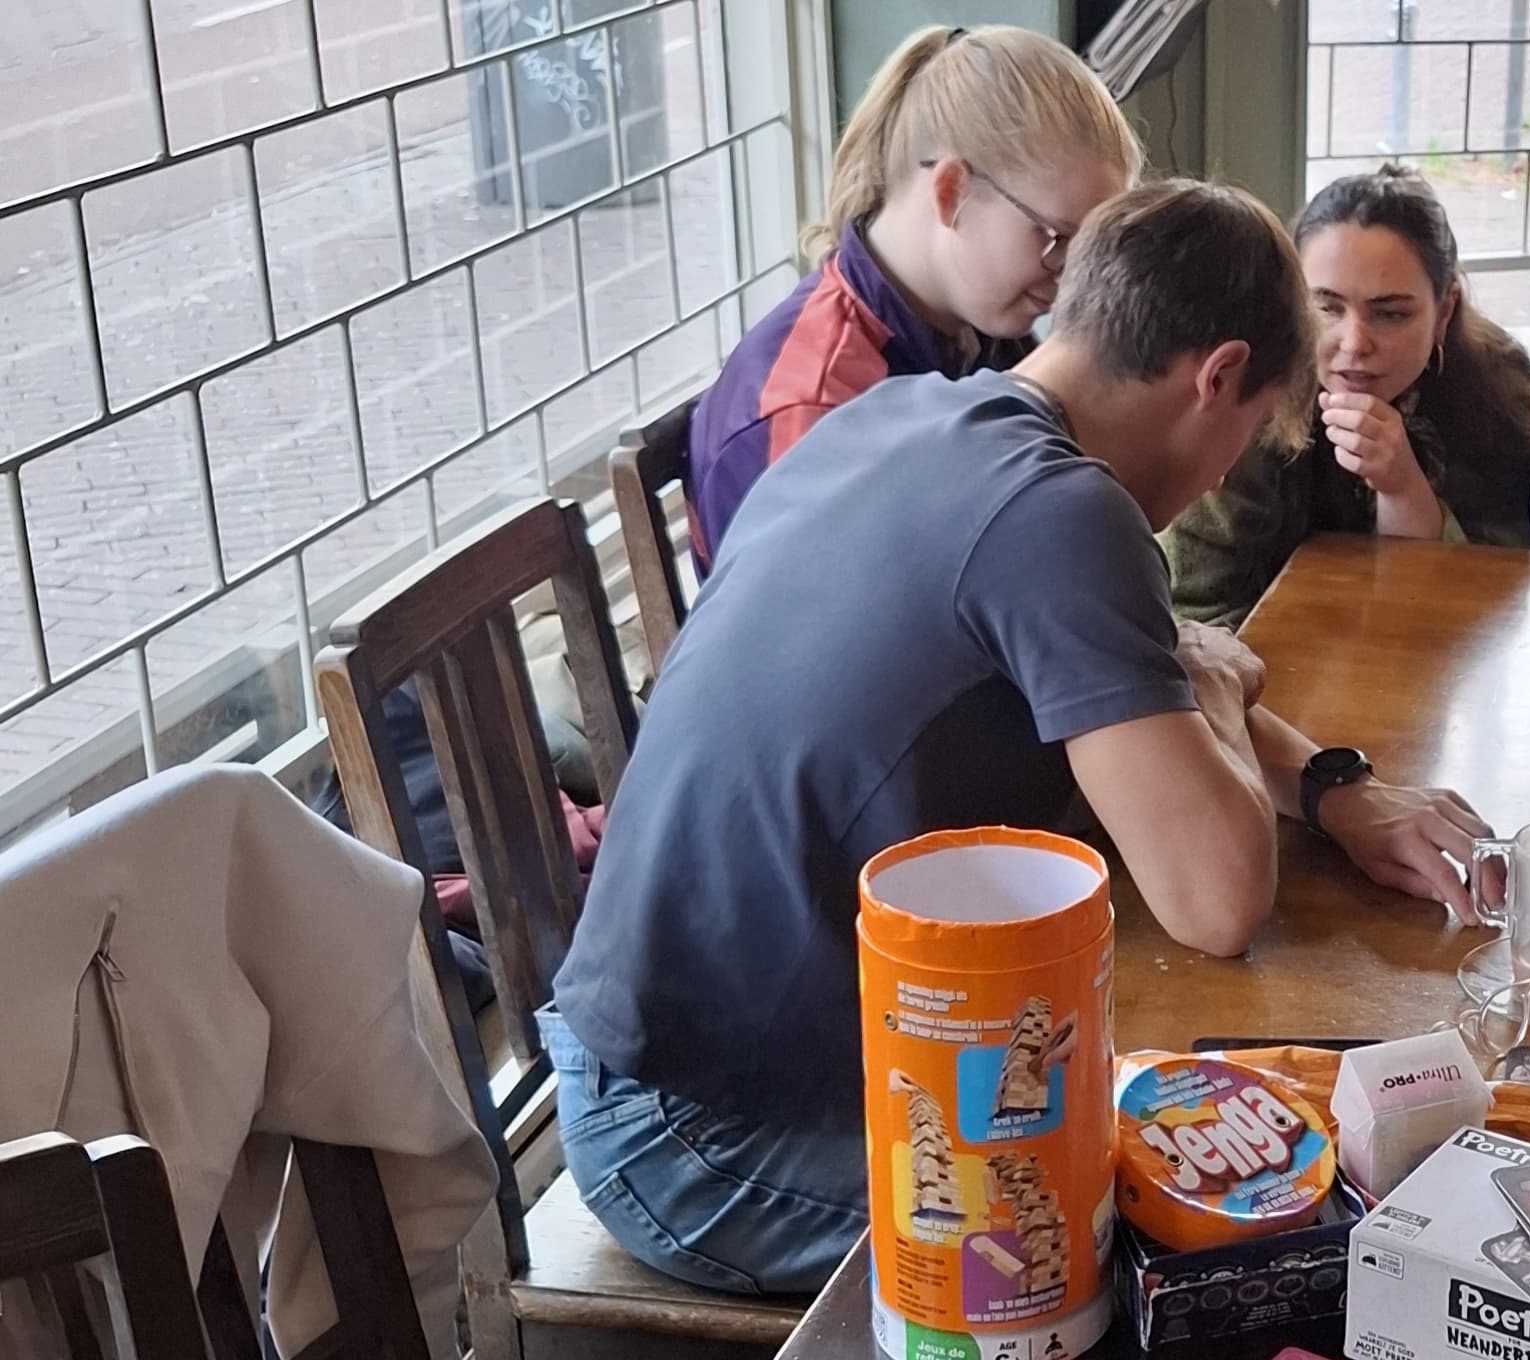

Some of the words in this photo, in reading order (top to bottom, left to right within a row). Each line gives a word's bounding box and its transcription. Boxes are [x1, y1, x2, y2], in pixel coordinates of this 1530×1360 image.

[1139, 1085, 1302, 1190] Jenga
[917, 1340, 945, 1358] Jeux
[948, 1346, 966, 1360] de
[999, 1341, 1018, 1351] AGE
[1355, 1340, 1382, 1356] MOET
